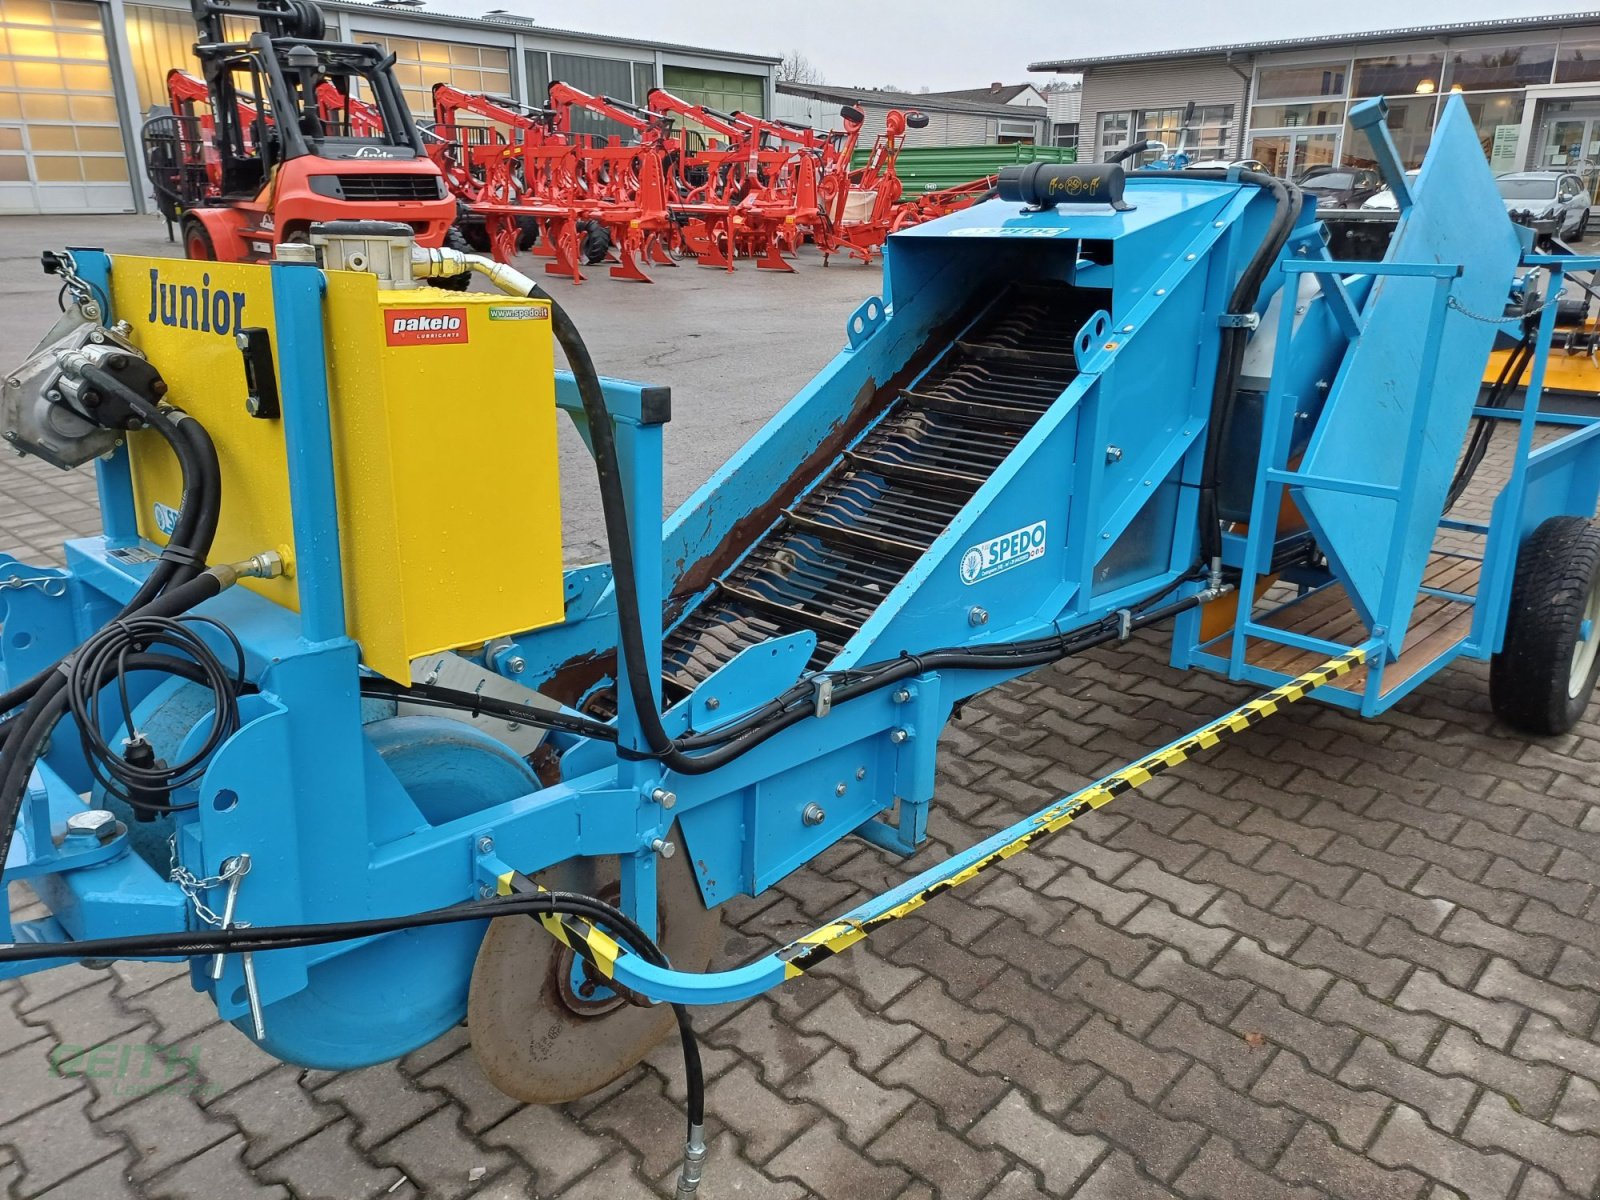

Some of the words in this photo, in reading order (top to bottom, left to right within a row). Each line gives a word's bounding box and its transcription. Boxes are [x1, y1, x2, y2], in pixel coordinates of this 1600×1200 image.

[347, 146, 394, 159] Linde
[148, 268, 246, 337] Junior
[490, 306, 548, 318] www.spedo.it
[393, 315, 461, 334] pakelo
[989, 525, 1044, 565] SPEDO
